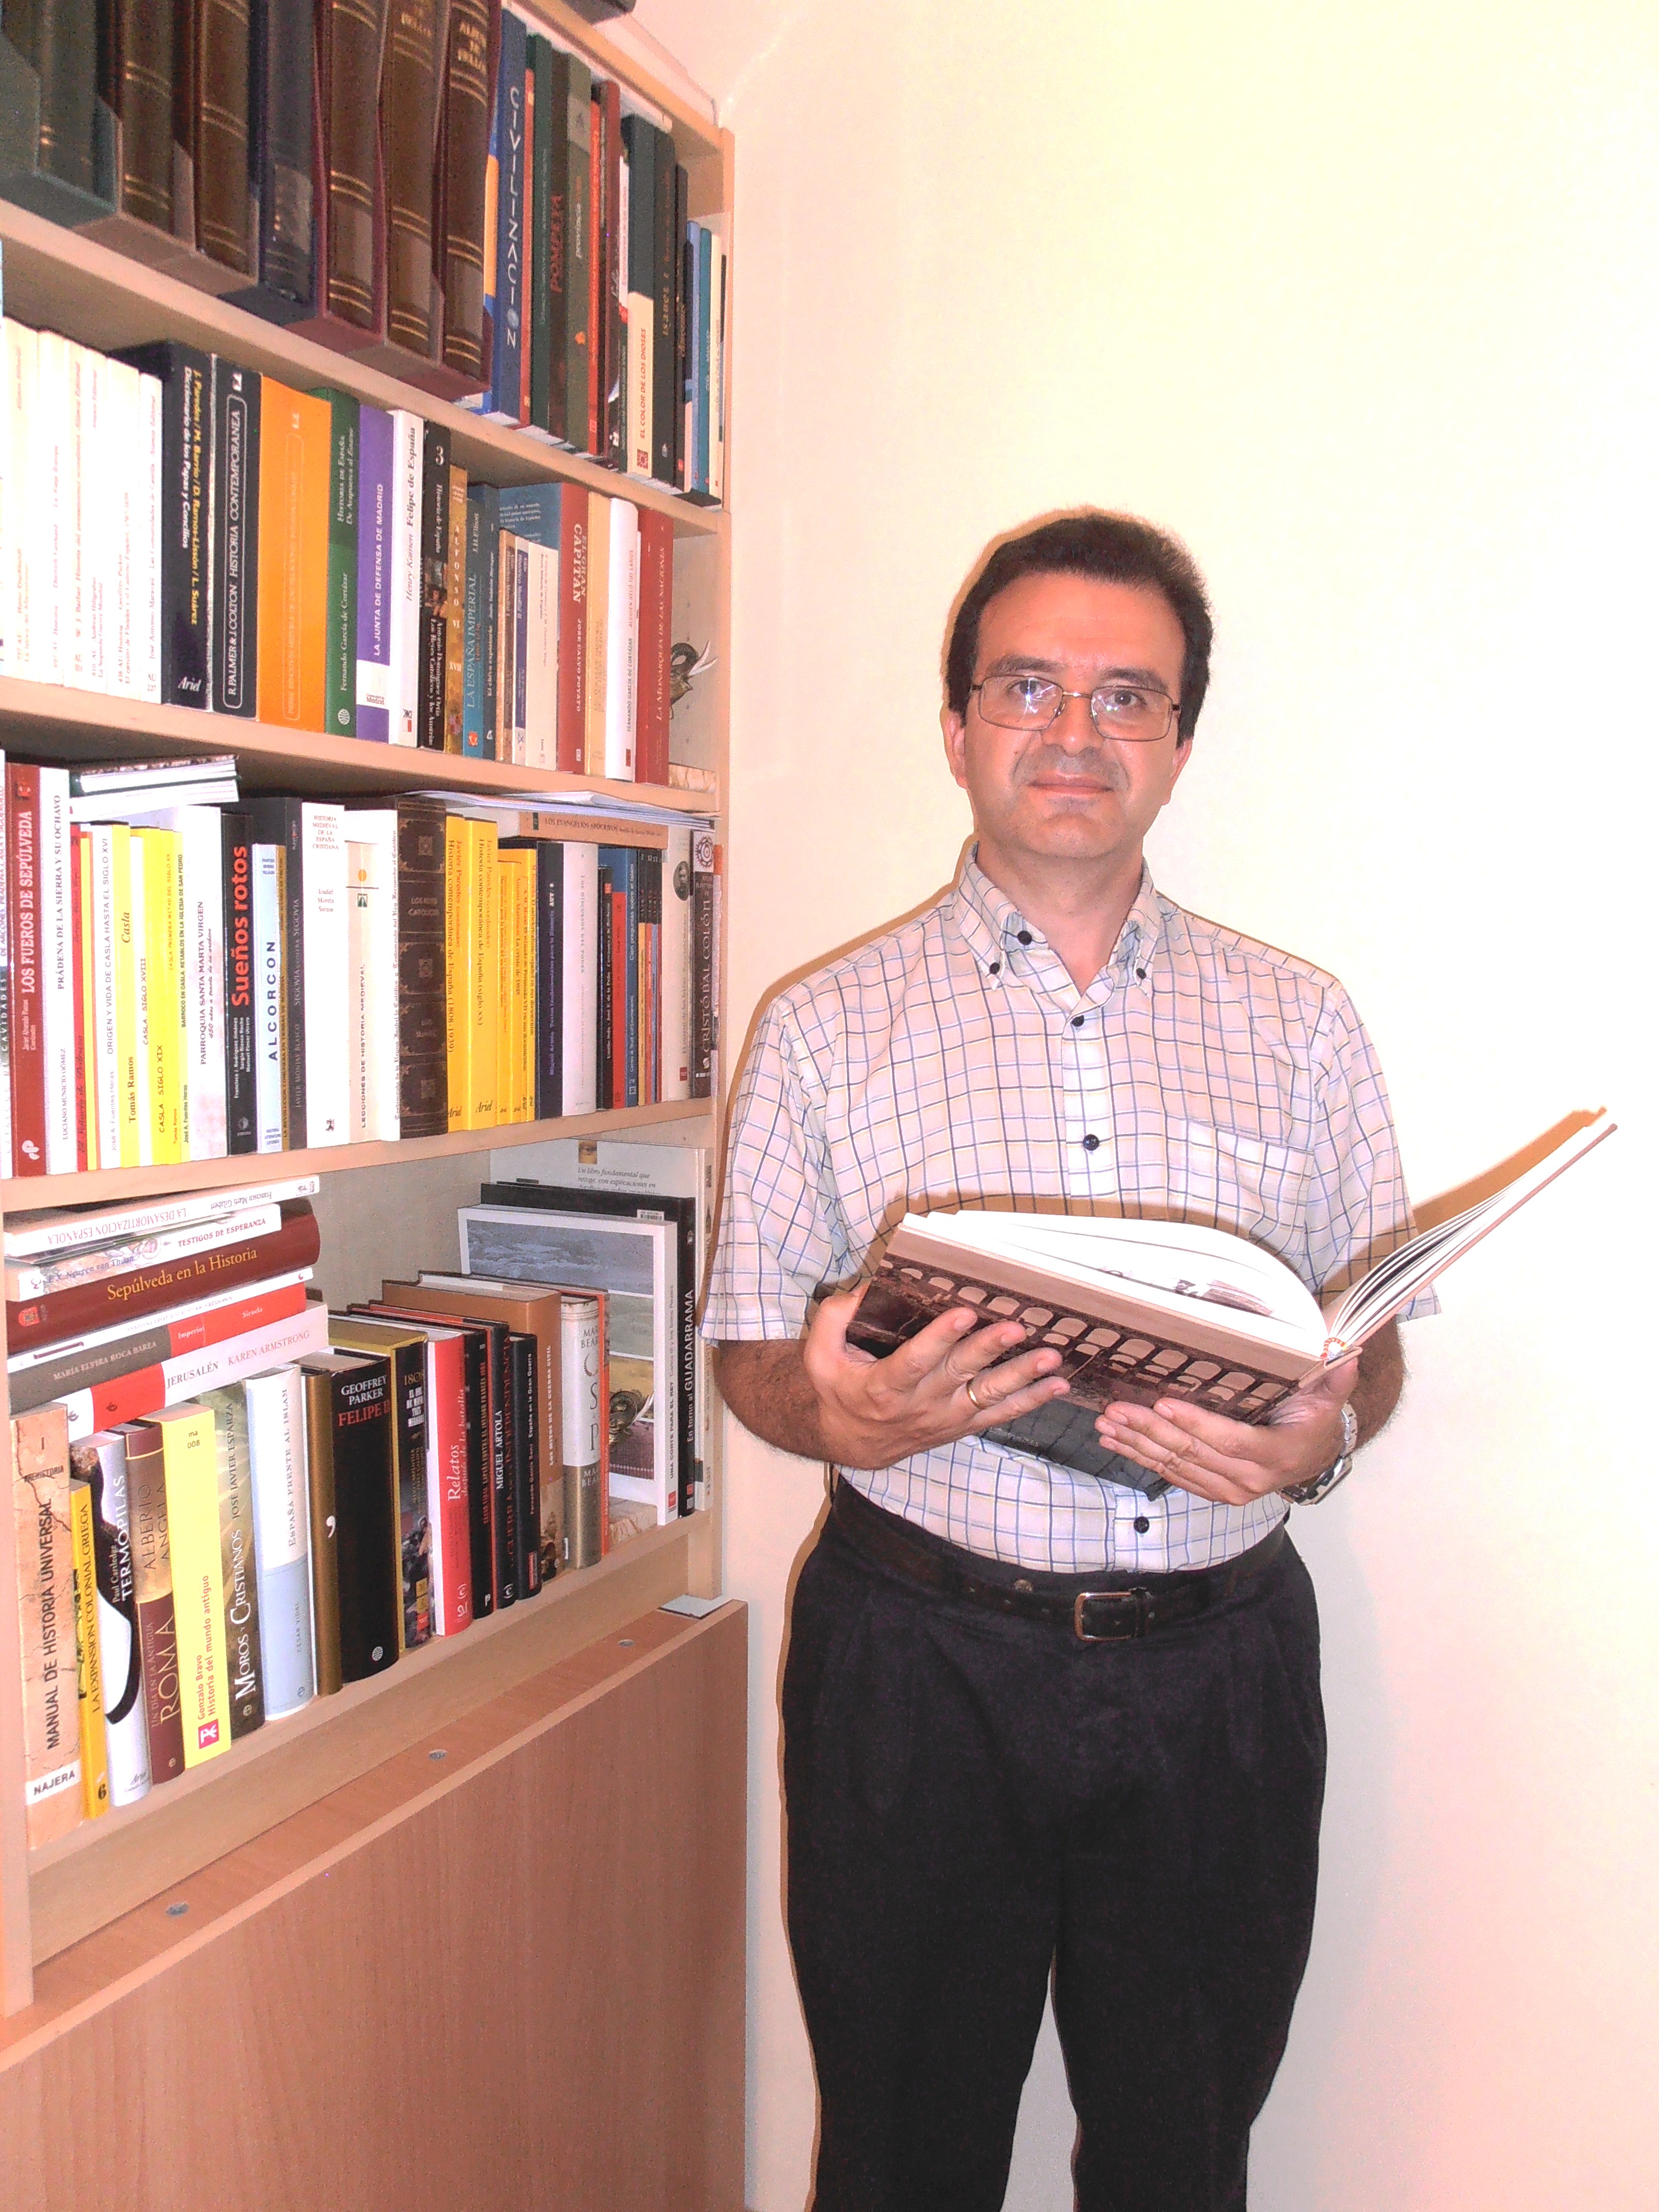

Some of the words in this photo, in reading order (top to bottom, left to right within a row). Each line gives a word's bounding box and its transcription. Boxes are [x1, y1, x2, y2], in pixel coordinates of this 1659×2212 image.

[183, 367, 192, 427] Diccionario
[640, 381, 646, 393] DE
[183, 428, 191, 441] de
[407, 427, 416, 469] España
[639, 429, 645, 438] EL
[182, 443, 191, 459] los
[436, 445, 445, 465] 3
[182, 460, 191, 491] Papas
[406, 474, 415, 488] de
[406, 491, 415, 527] Felipe
[181, 502, 190, 548] Concilios
[375, 528, 382, 541] DE
[229, 526, 238, 577] HISTORIA
[405, 533, 414, 569] Kamen
[375, 592, 382, 606] DE
[405, 572, 414, 601] Henry
[340, 611, 348, 621] de
[467, 575, 476, 636] IMPERIAL
[374, 644, 381, 656] LA
[465, 640, 475, 687] ESPAÑA
[178, 676, 201, 692] Ariel
[467, 690, 474, 707] LA
[16, 811, 32, 887] SEPÚLVEDA
[55, 842, 62, 855] SU
[55, 867, 63, 904] SIERRA
[231, 846, 248, 910] rotos
[20, 890, 33, 908] DE
[103, 888, 110, 899] EL
[56, 908, 63, 921] LA
[121, 912, 131, 943] Casla
[20, 913, 34, 964] FUEROS
[56, 924, 63, 937] DE
[231, 917, 249, 1005] Sueños
[21, 968, 34, 993] LOS
[105, 970, 111, 983] DE
[267, 941, 277, 1061] ALCORCON
[701, 964, 710, 1052] CRISTÓBAL
[127, 1057, 136, 1087] Ramos
[360, 1060, 366, 1072] DE
[127, 1092, 136, 1123] Tomás
[96, 1211, 174, 1235] DESAMORTIZACIÓN
[177, 1208, 187, 1218] LA
[48, 1227, 92, 1245] ESPAÑOLA
[178, 1232, 213, 1247] TESTIGOS
[227, 1218, 266, 1234] ESPERANZA
[107, 1270, 173, 1300] Sepúlveda
[176, 1268, 191, 1280] en
[194, 1260, 205, 1275] la
[208, 1247, 257, 1271] Historia
[227, 1349, 256, 1364] KAREN
[258, 1331, 309, 1355] ARMSTRONG
[684, 1290, 694, 1391] GUADARRAMA
[167, 1361, 219, 1388] JERUSALÉN
[340, 1374, 387, 1396] GEOFFREY
[281, 1389, 289, 1423] ISLAM
[348, 1388, 384, 1406] PARKER
[685, 1393, 694, 1402] al
[224, 1403, 236, 1450] ESPARZA
[338, 1403, 382, 1427] FELIPE
[495, 1410, 503, 1447] ARTOLA
[685, 1404, 694, 1427] torno
[187, 1439, 200, 1449] 008
[283, 1428, 290, 1443] AL
[686, 1430, 694, 1441] En
[227, 1454, 238, 1491] JAVIER
[284, 1449, 293, 1495] FRENTE
[446, 1445, 461, 1500] Relatos
[495, 1451, 503, 1488] MIGUEL
[230, 1494, 240, 1519] JOSÉ
[79, 1504, 91, 1555] GRIEGA
[112, 1475, 134, 1601] TERMÓPILAS
[286, 1501, 296, 1547] ESPAÑA
[39, 1498, 55, 1582] UNIVERSAL
[82, 1555, 95, 1623] COLONIAL
[201, 1575, 212, 1614] antiguo
[41, 1586, 57, 1654] HISTORIA
[203, 1618, 213, 1652] mundo
[43, 1658, 58, 1681] DE
[86, 1624, 99, 1692] EXPANSION
[154, 1615, 180, 1722] ROMA
[195, 1654, 204, 1681] Bravo
[204, 1655, 214, 1671] del
[90, 1695, 101, 1712] LA
[196, 1683, 205, 1720] Gonzalo
[205, 1675, 216, 1715] Historia
[44, 1685, 60, 1749] MANUAL
[34, 1770, 75, 1795] NAJERA
[97, 1783, 107, 1800] 6
